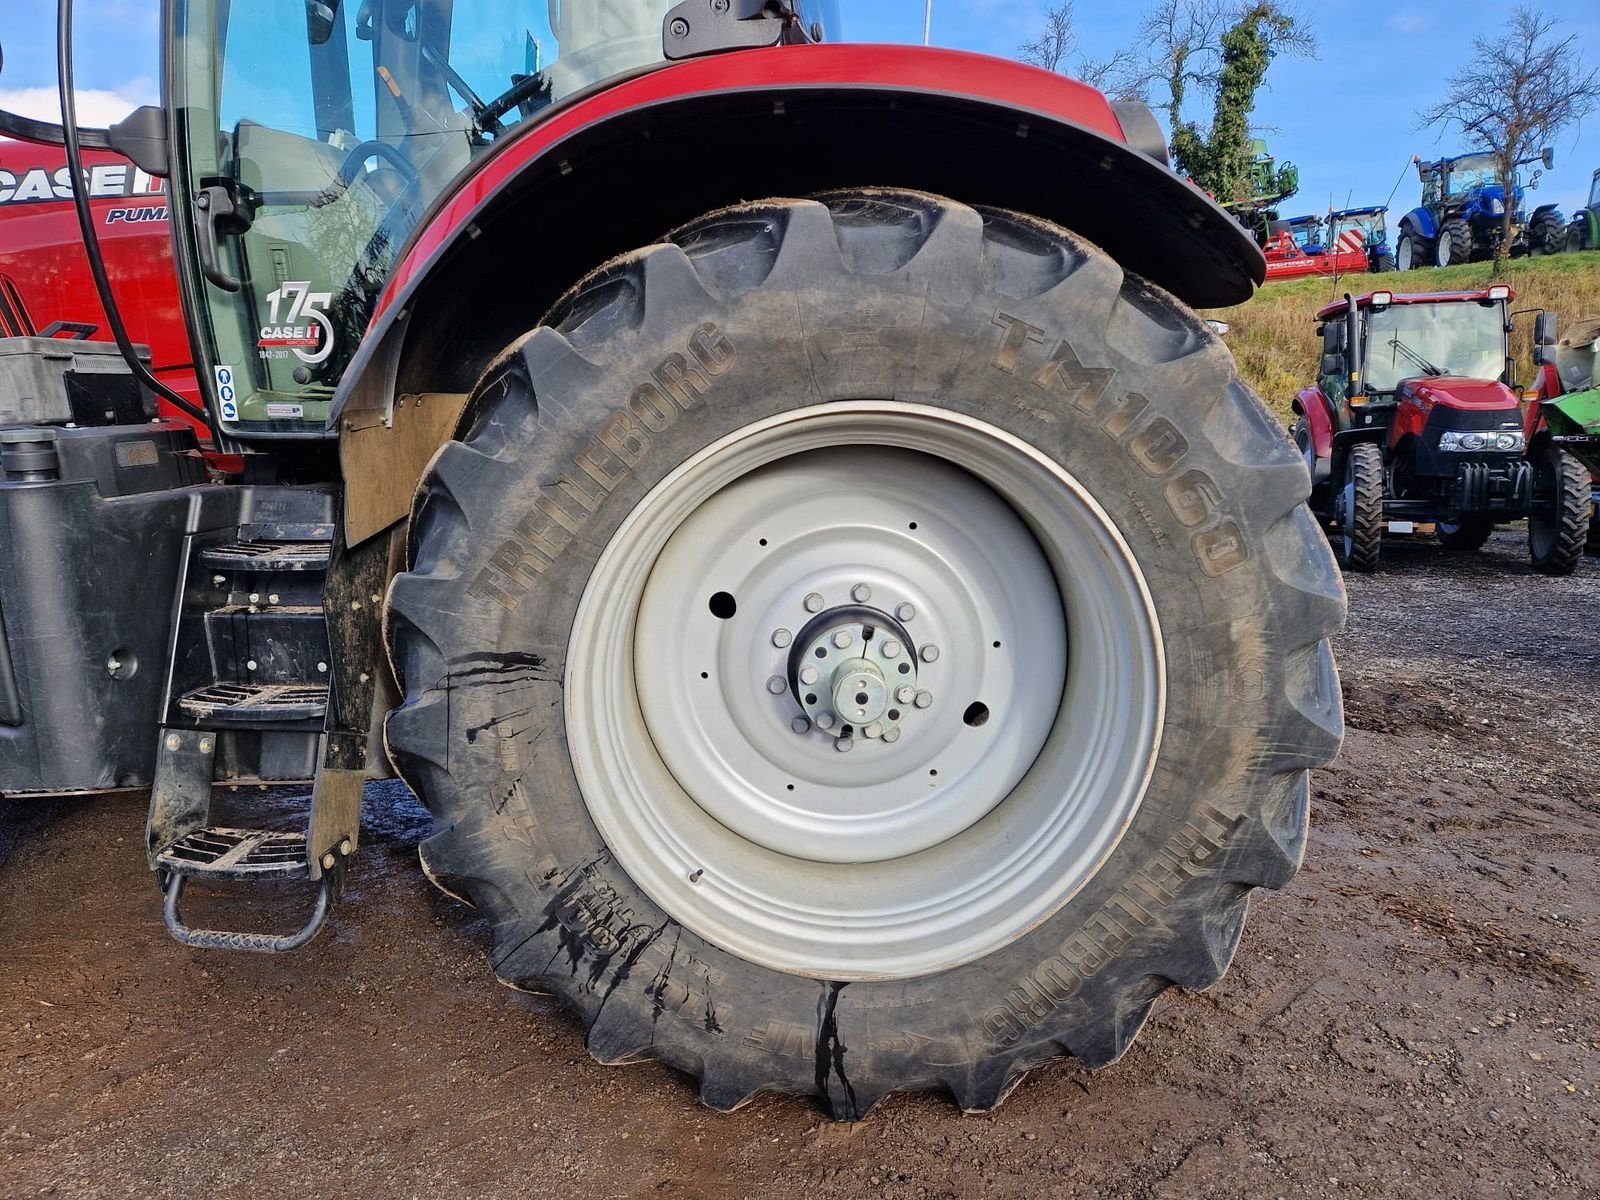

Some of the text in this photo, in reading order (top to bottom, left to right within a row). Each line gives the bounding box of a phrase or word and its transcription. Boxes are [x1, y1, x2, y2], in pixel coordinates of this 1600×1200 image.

[106, 206, 169, 224] PUM
[259, 350, 289, 359] 1842-2017
[260, 326, 304, 339] CASE
[266, 281, 335, 363] 175
[466, 321, 736, 613] TRELLEBORG
[990, 306, 1248, 578] TM1060
[984, 801, 1250, 1049] TRELLEBORG
